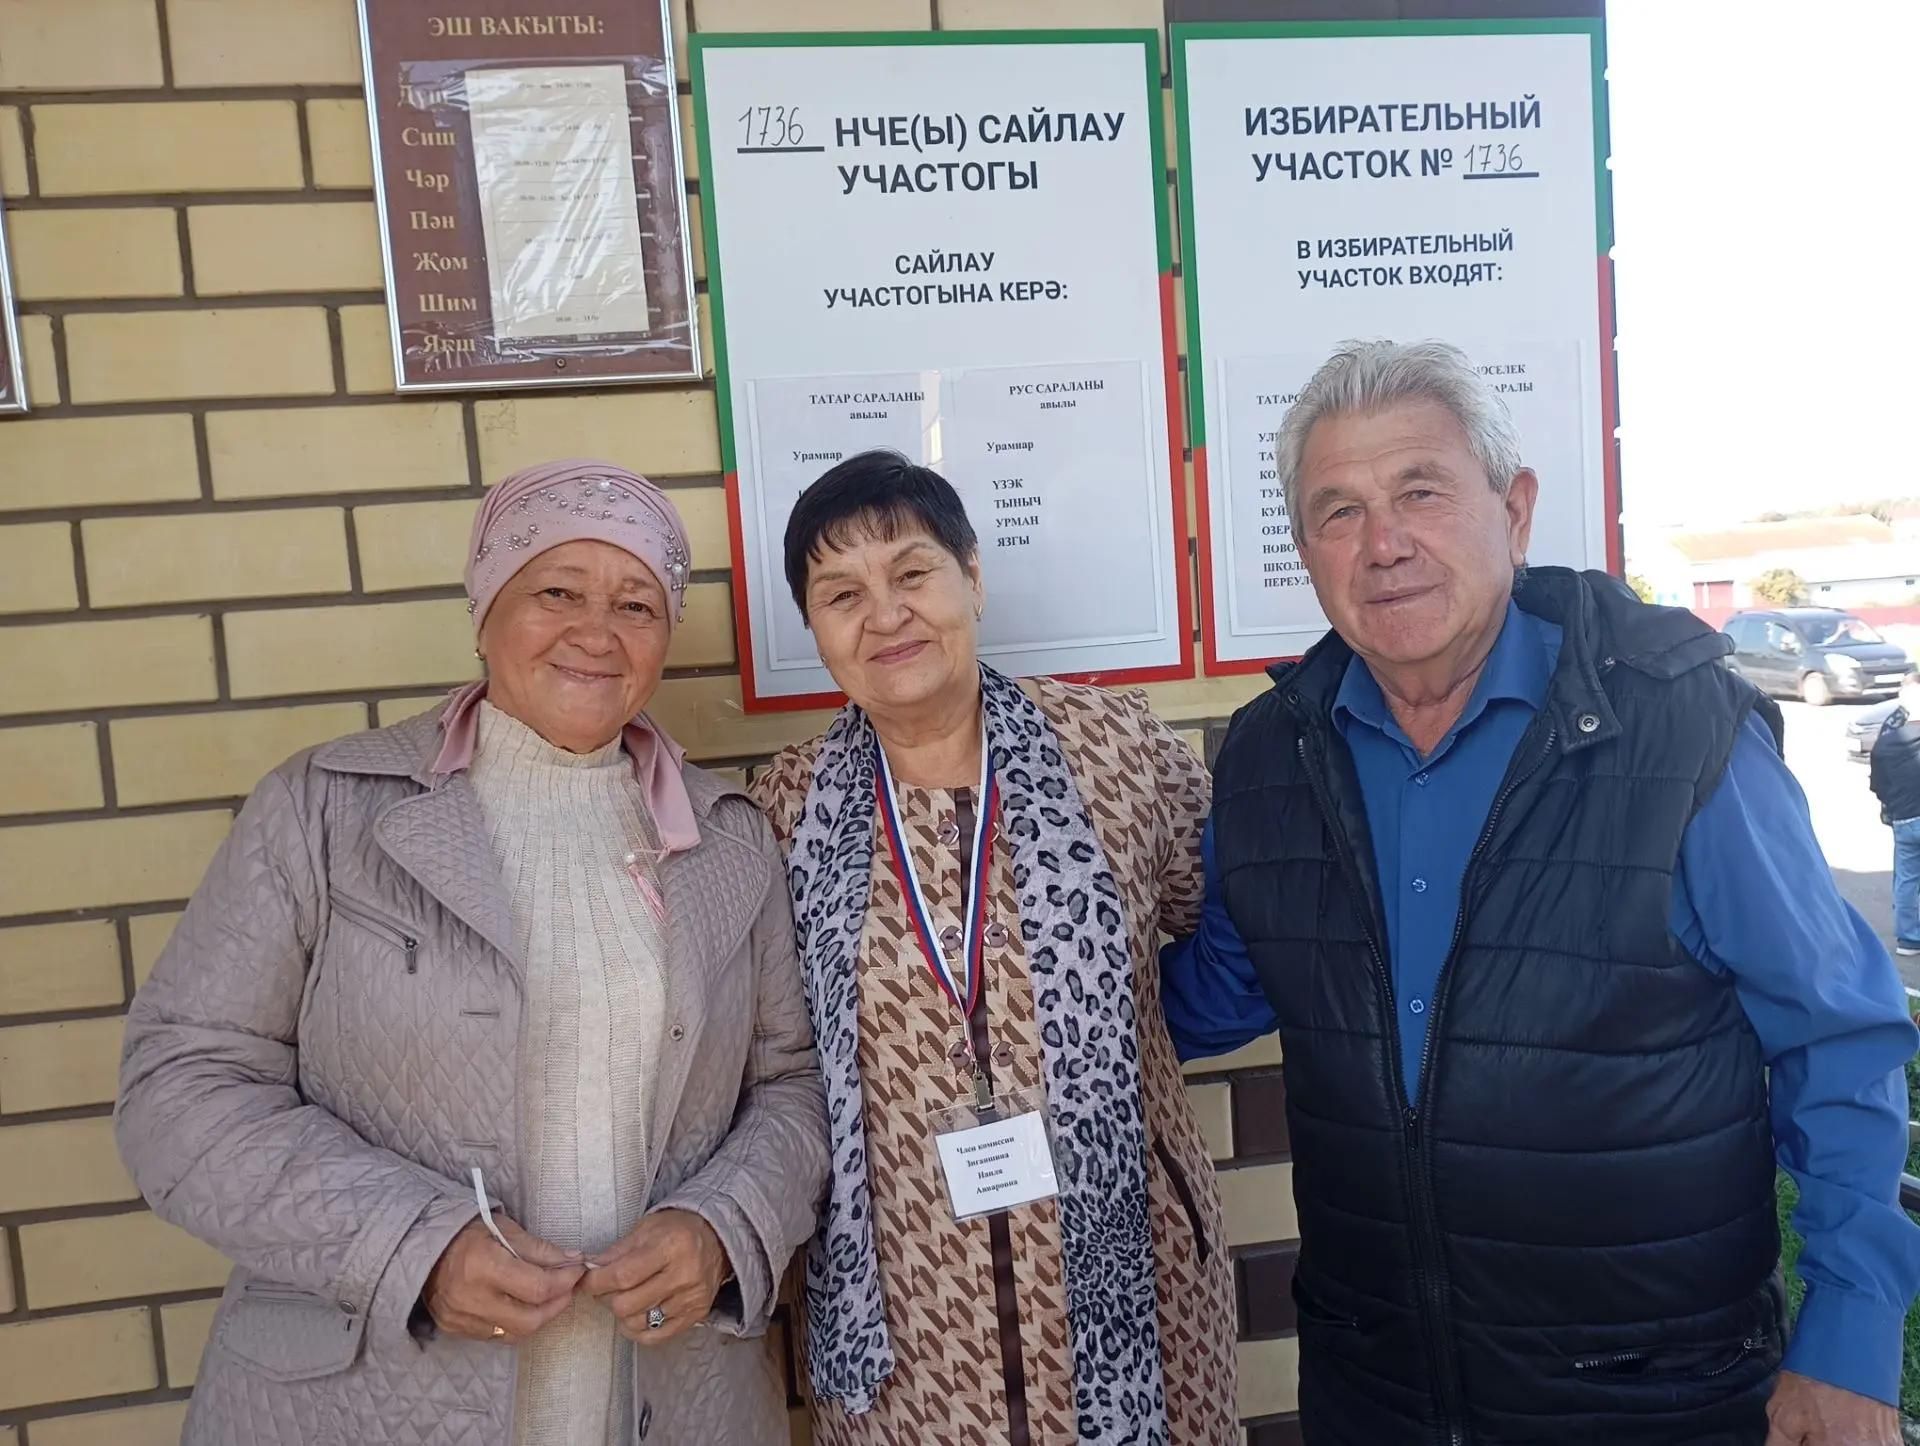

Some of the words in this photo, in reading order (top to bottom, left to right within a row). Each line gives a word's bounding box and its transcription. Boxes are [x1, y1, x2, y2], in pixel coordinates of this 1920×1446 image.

[429, 17, 472, 36] ЭШ
[480, 16, 604, 36] ВАКЫТЫ:
[1244, 94, 1541, 136] ИЗБИРАТЕЛЬНЫЙ
[401, 127, 455, 146] Сиш
[738, 106, 805, 147] 1736
[835, 112, 967, 153] НЧЕ(Ы)
[978, 107, 1125, 144] САЙЛАУ
[1252, 149, 1411, 182] УЧАСТОК
[1421, 147, 1453, 176] №
[1464, 144, 1524, 173] 1736
[405, 169, 449, 192] Чәр
[838, 161, 1038, 195] УЧАСТОГЫ
[410, 211, 455, 229] Пән
[1297, 241, 1311, 259] В
[1317, 228, 1514, 258] ИЗБИРАТЕЛЬНЫЙ
[895, 249, 995, 274] САЙЛАУ
[1297, 267, 1403, 289] УЧАСТОК
[1409, 262, 1503, 287] ВХОДЯТ:
[419, 294, 477, 312] Шим
[824, 284, 994, 308] УЧАСТОГЫНА
[1000, 280, 1069, 303] КЕРӘ:
[423, 334, 476, 352] Якш
[1009, 385, 1033, 396] РУС
[1035, 380, 1105, 394] САРАЛАНЫ
[809, 394, 851, 405] ТАТАР
[853, 391, 926, 404] САРАЛАНЫ
[1040, 401, 1077, 410] авылы
[849, 411, 888, 420] авылы
[986, 440, 1034, 453] Урамнар
[793, 451, 843, 463] Урамнар
[994, 496, 1042, 509] ТЫНЫЧ
[996, 516, 1039, 528] УРМАН
[997, 535, 1030, 547] ЯЗГЫ
[956, 1146, 976, 1154] Член
[978, 1136, 1015, 1150] комиссии
